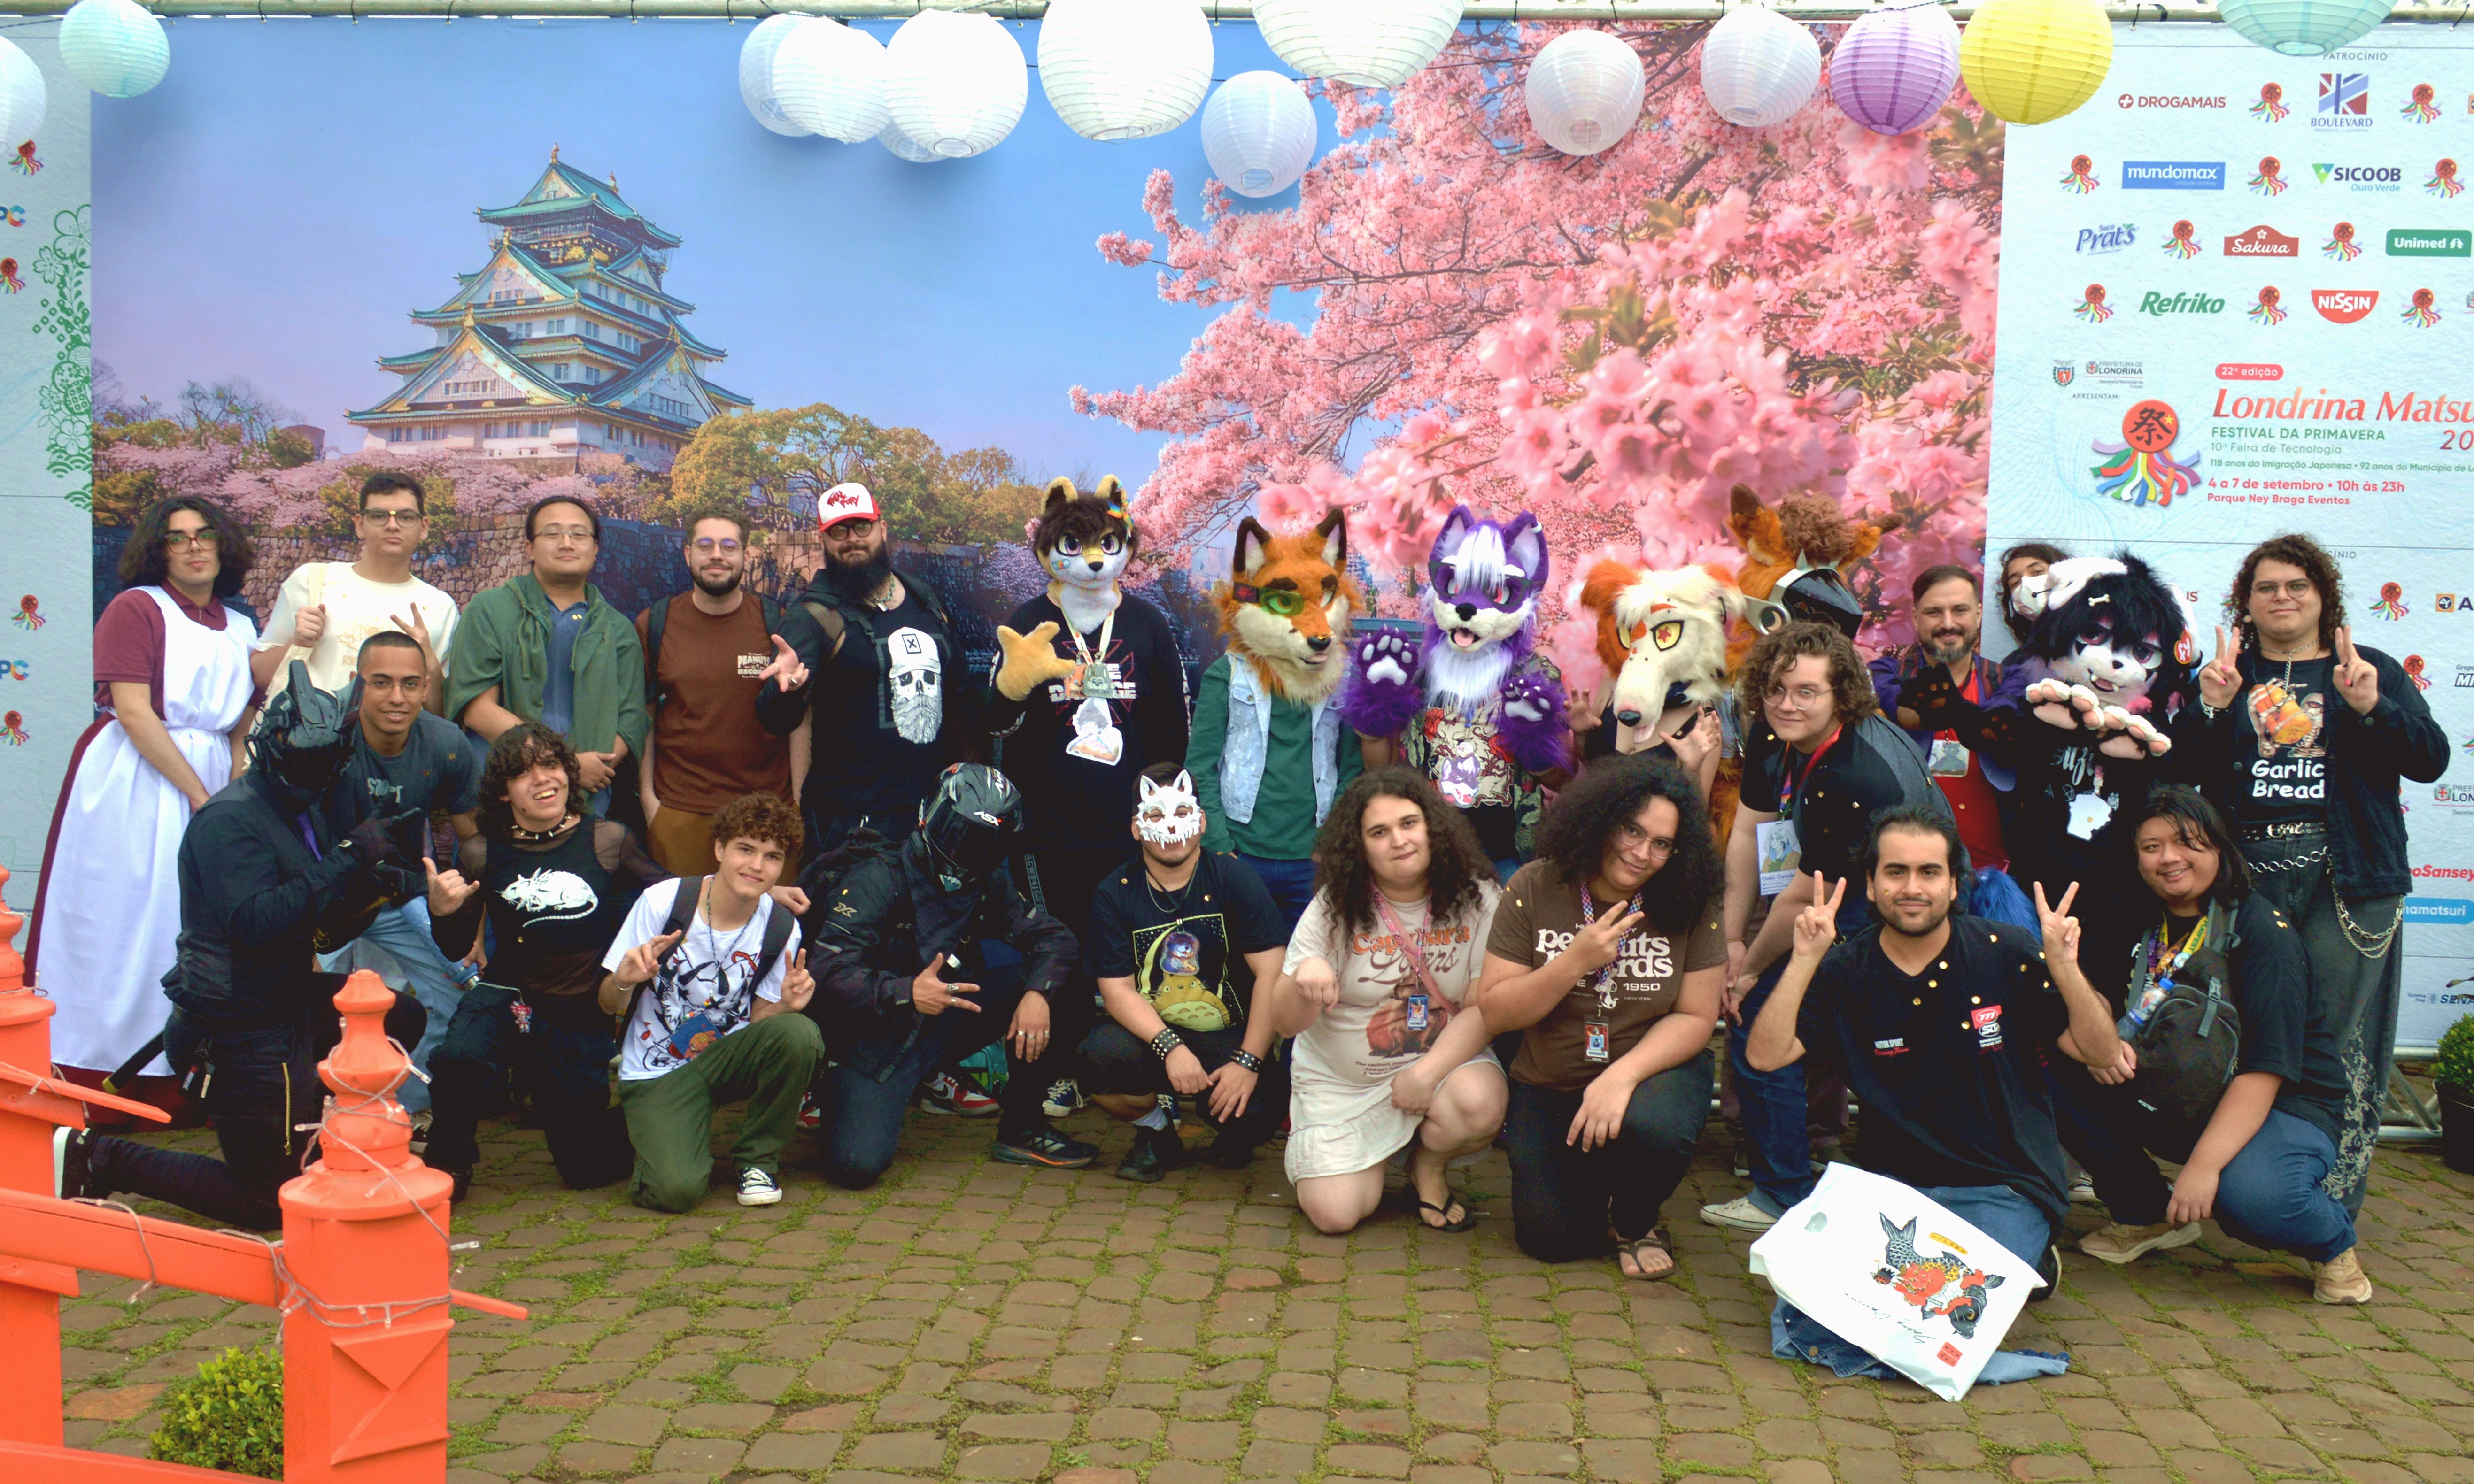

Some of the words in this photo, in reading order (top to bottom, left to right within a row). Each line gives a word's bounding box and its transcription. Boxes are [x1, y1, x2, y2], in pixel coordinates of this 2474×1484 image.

[2323, 51, 2387, 61] PATROCÍNIO
[2138, 96, 2227, 108] DROGAMAIS
[2311, 118, 2373, 128] BOULEVARD
[2128, 165, 2218, 180] mundomax
[2334, 167, 2401, 182] SICOOB
[2231, 238, 2290, 254] Sakura
[2394, 237, 2446, 248] Unimed
[2138, 291, 2226, 316] Refriko
[2318, 292, 2371, 313] NISSIN
[2241, 367, 2278, 378] edição
[2212, 386, 2366, 421] Londrina
[2128, 407, 2172, 446] 祭
[2211, 427, 2274, 438] FESTIVAL
[2280, 428, 2299, 439] DA
[2304, 428, 2385, 441] PRIMAVERA
[2231, 443, 2257, 452] Feira
[2262, 443, 2276, 452] de
[2281, 443, 2342, 455] Tecnologia
[2262, 460, 2306, 470] Imigração
[2308, 461, 2351, 470] Japonesa
[2208, 477, 2217, 488] 4
[2220, 479, 2228, 488] a
[2232, 477, 2240, 488] 7
[2242, 478, 2259, 489] de
[2262, 479, 2324, 491] setembro
[2336, 480, 2359, 491] 10h
[2363, 481, 2378, 492] às
[2381, 481, 2405, 492] 23h
[2207, 493, 2246, 504] Parque
[2249, 493, 2269, 504] Ney
[2272, 494, 2304, 506] Braga
[2308, 495, 2350, 505] Eventos
[2326, 550, 2357, 559] CÍNIO
[2251, 759, 2325, 778] Garlic
[2252, 779, 2325, 799] Bread
[2408, 864, 2474, 882] oSansey
[1353, 925, 1471, 955] Capbara
[1535, 928, 1670, 957] peuts
[1357, 946, 1459, 985] Loers
[1544, 948, 1674, 978] rrds
[1623, 983, 1661, 991] 1950
